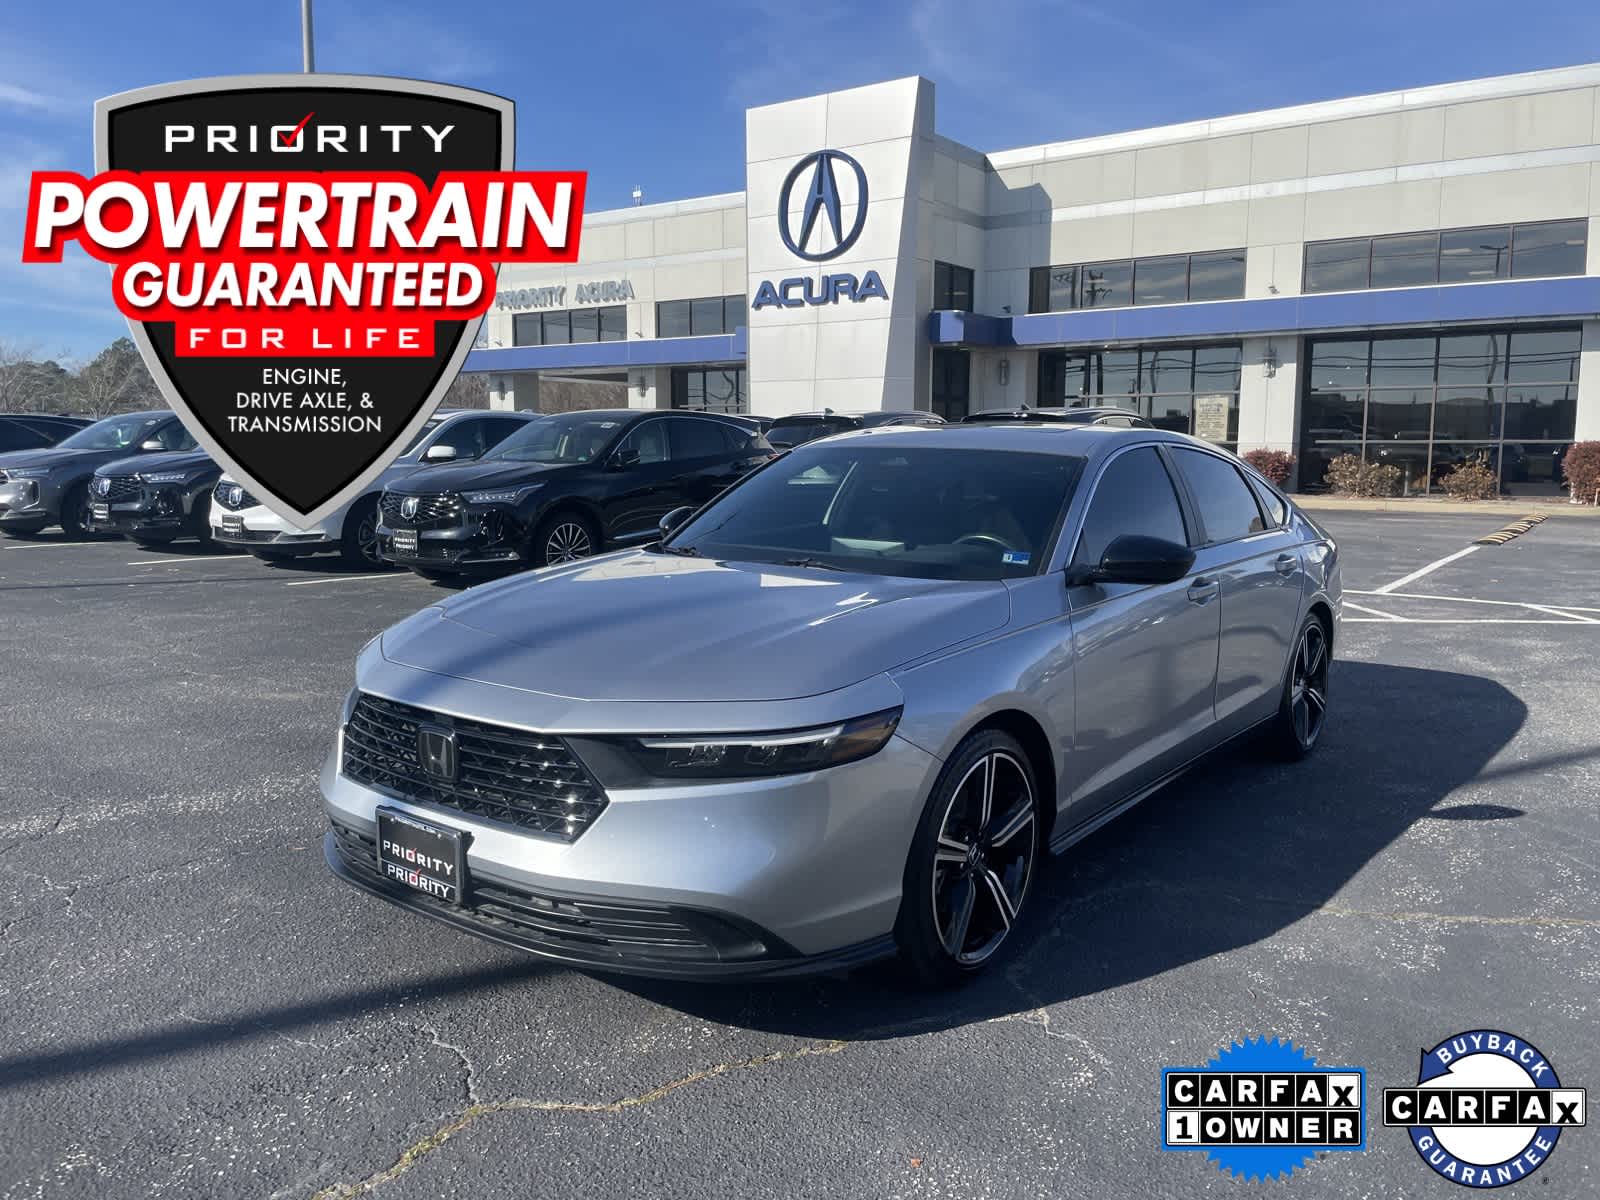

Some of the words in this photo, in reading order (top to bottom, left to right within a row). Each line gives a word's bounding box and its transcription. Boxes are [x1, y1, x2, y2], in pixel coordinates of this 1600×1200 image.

[495, 285, 567, 311] PRIORITY
[575, 279, 635, 304] ACURA
[751, 270, 889, 309] ACURA
[383, 840, 453, 876] PRIORITY
[387, 864, 449, 898] PRIORITY
